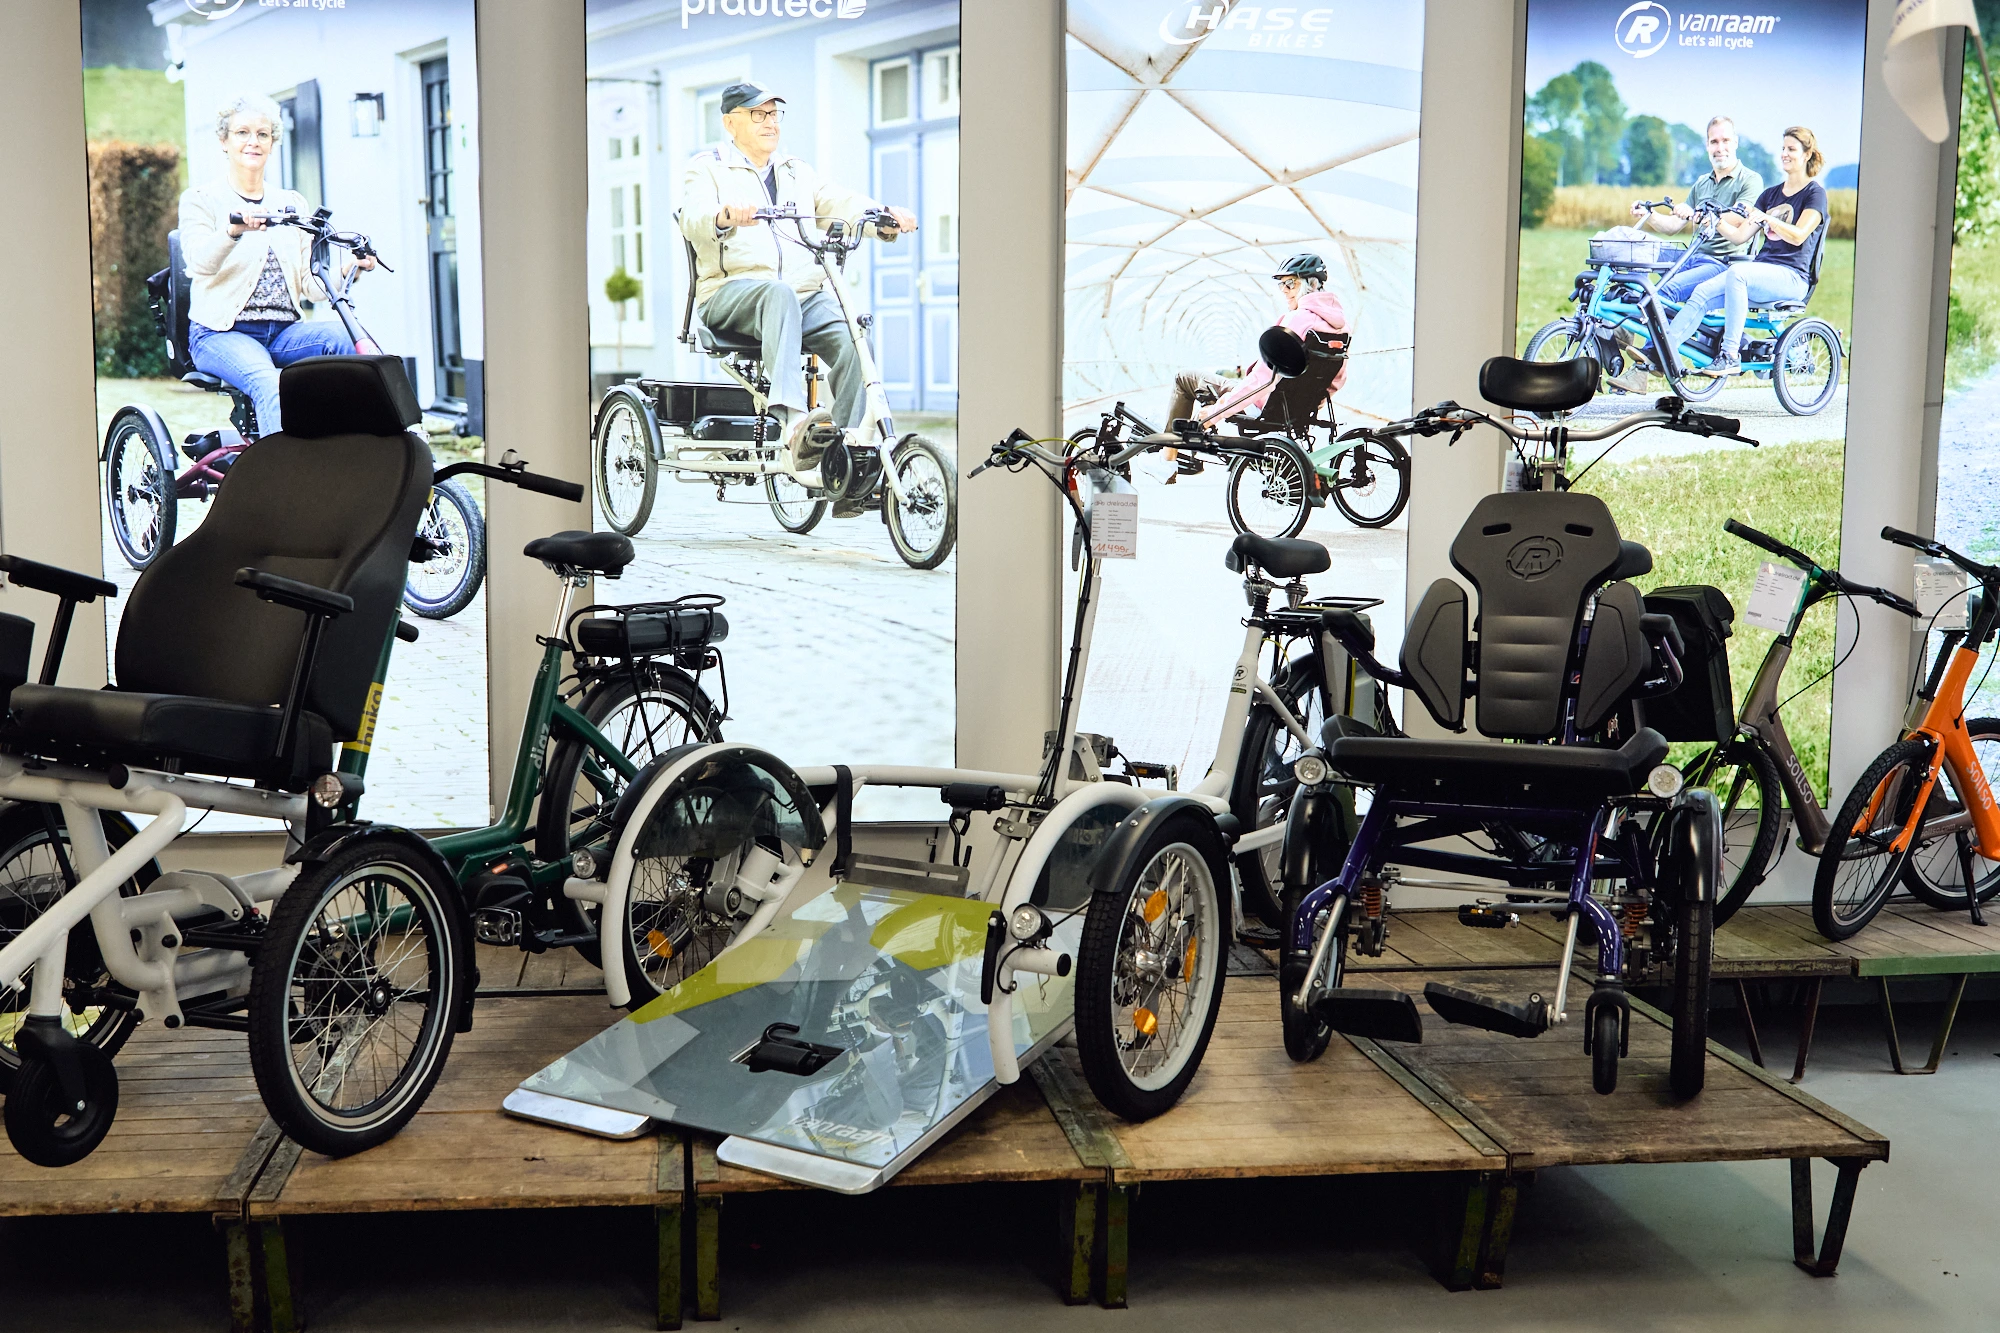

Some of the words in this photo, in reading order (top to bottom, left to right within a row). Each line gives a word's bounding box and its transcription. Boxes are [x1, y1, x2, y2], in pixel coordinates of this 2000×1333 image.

[1185, 5, 1334, 32] HASE
[1248, 33, 1325, 48] BIKES
[1678, 33, 1706, 47] Let's
[1708, 34, 1723, 47] all
[1724, 35, 1754, 51] cycle
[356, 689, 383, 746] huka
